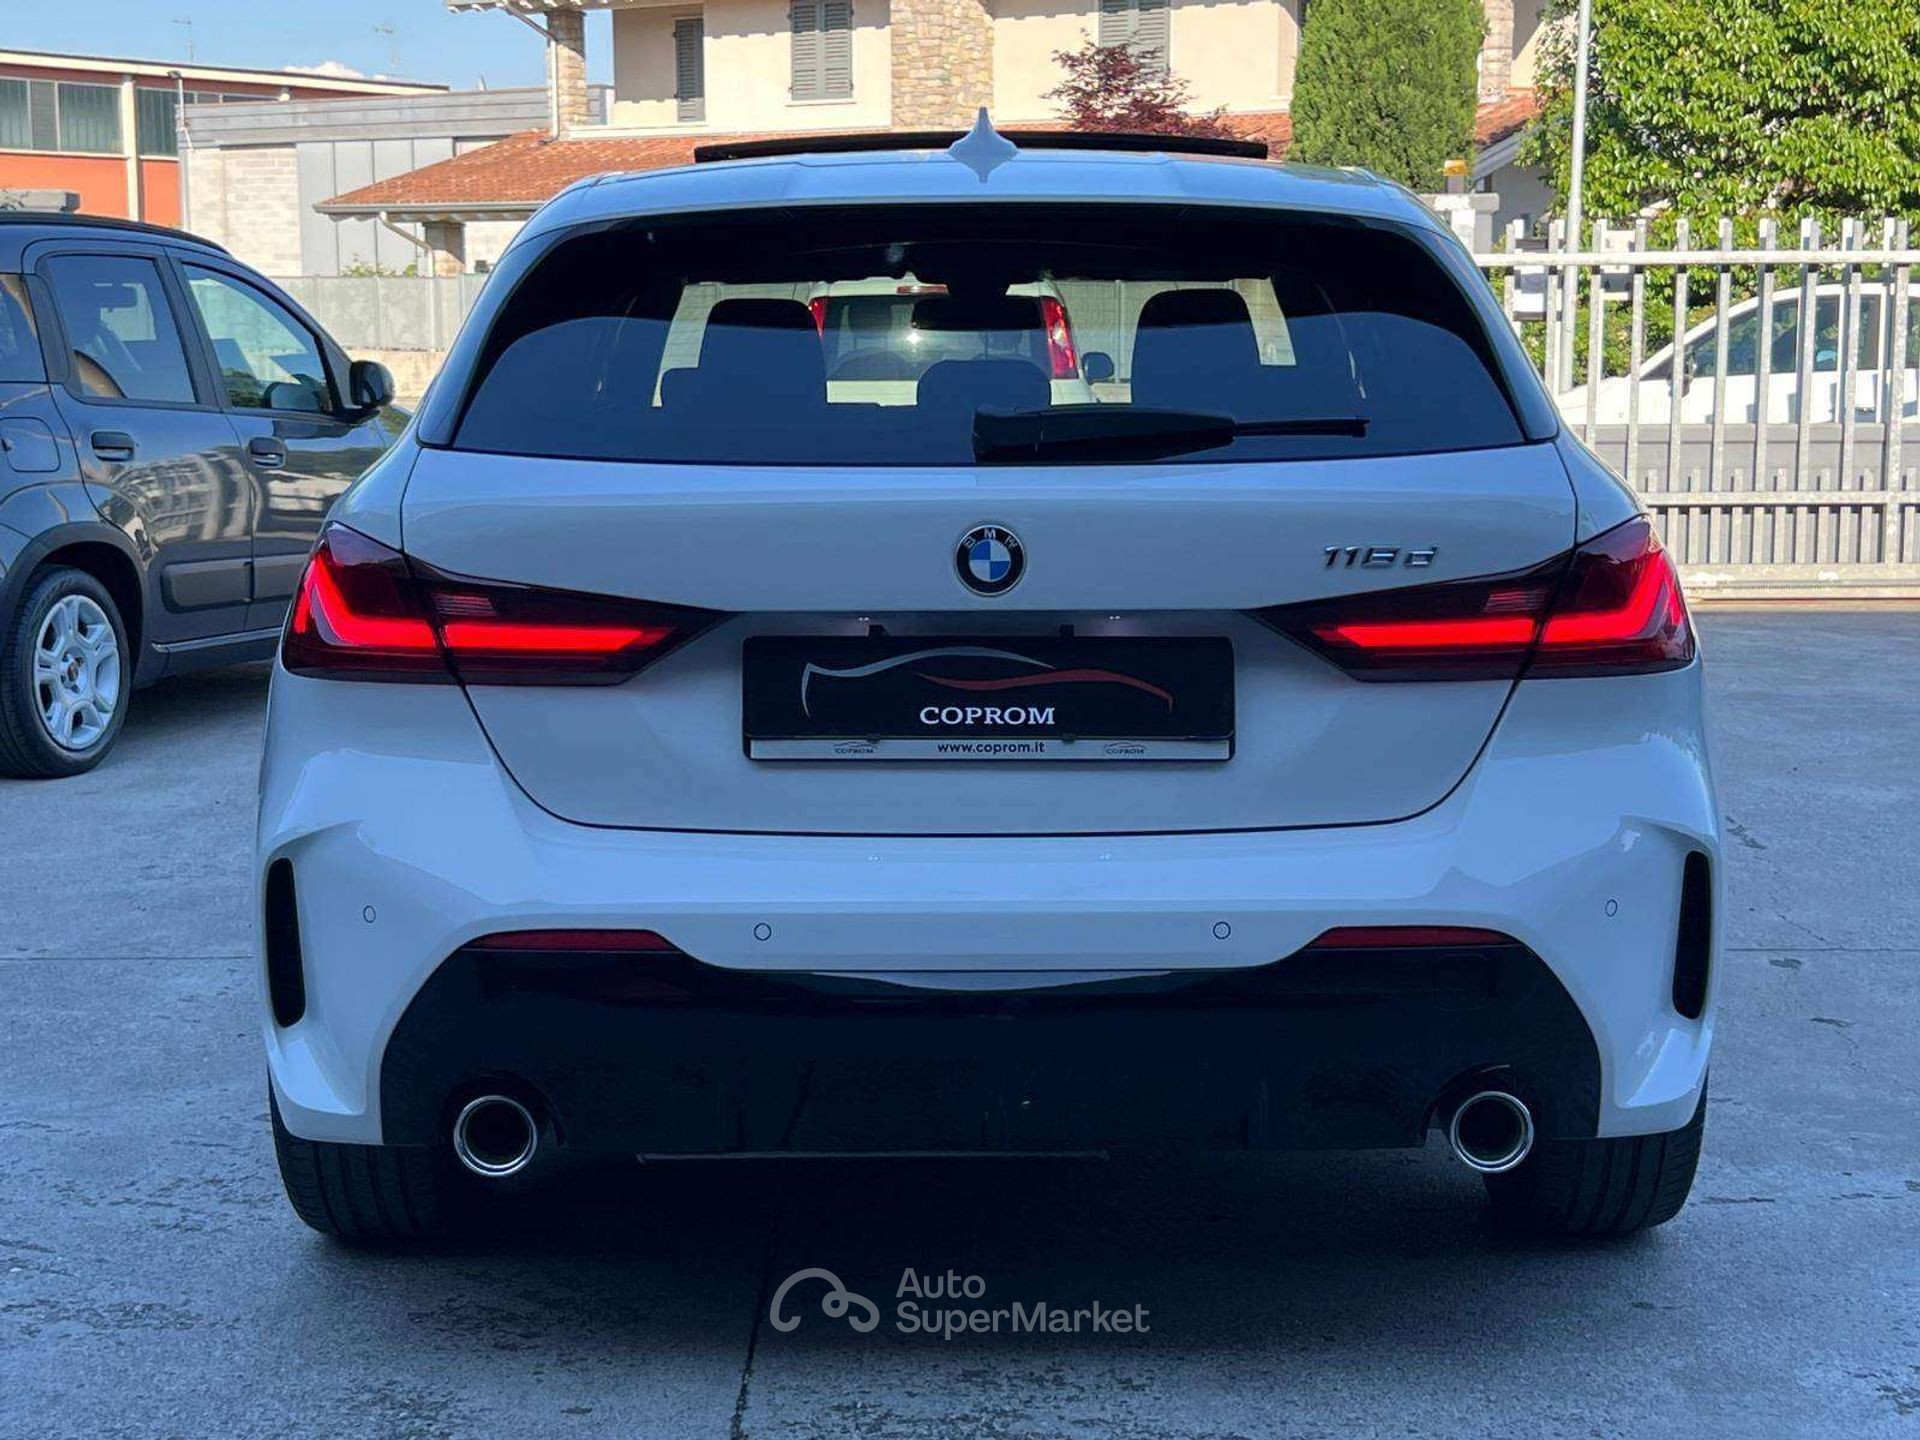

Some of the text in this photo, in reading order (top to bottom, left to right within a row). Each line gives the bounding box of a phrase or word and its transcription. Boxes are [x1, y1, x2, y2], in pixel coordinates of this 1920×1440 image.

[962, 528, 1018, 550] BMW
[920, 706, 1055, 725] COPROM
[937, 741, 1046, 754] www.coprom.it
